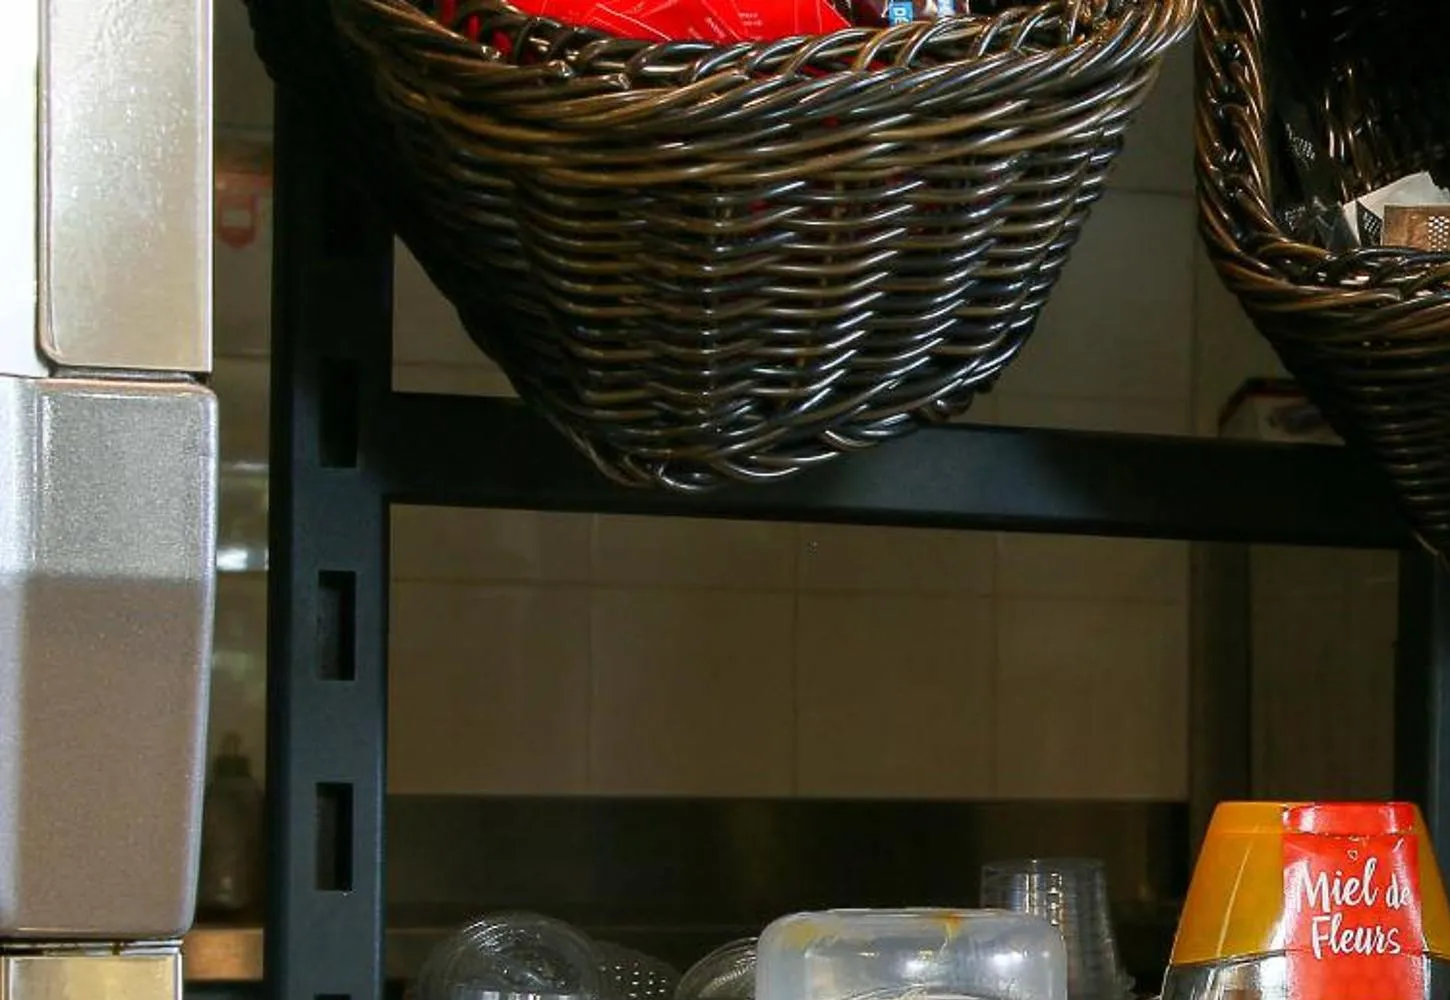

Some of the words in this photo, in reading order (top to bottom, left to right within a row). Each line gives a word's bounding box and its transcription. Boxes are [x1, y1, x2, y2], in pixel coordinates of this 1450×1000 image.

[1296, 857, 1379, 914] Miel
[1385, 871, 1414, 911] de
[1311, 912, 1402, 961] Fleurs
